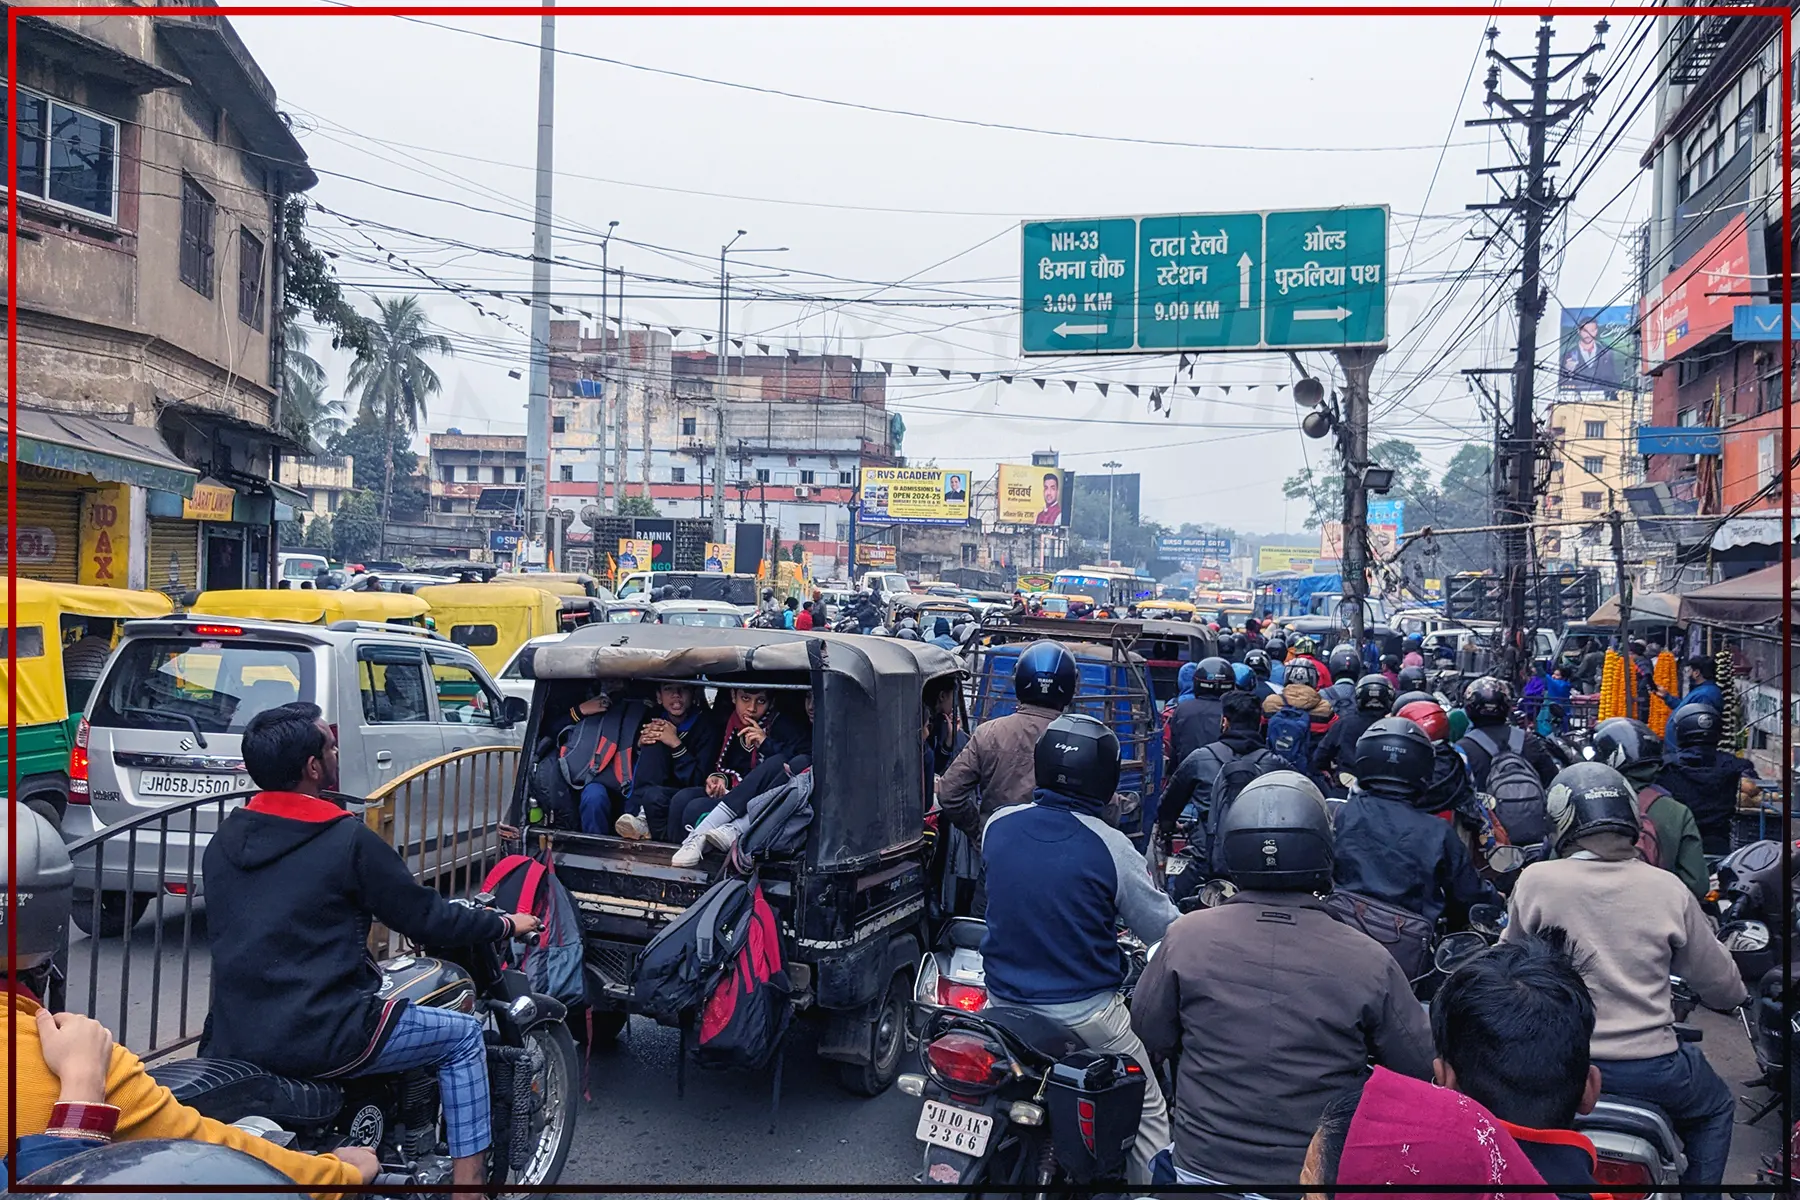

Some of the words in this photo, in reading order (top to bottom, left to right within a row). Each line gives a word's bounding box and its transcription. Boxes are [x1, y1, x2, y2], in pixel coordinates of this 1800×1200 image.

[1051, 231, 1099, 252] NH-33
[1150, 236, 1186, 259] टाटा
[1190, 229, 1229, 256] रेलवे
[1304, 225, 1347, 252] ओल्ड
[1038, 256, 1086, 281] डिमना
[1089, 254, 1126, 280] चौक
[1157, 262, 1208, 287] स्टेशन
[1274, 262, 1346, 295] पुरुलिया
[1350, 264, 1381, 285] पथ
[1043, 293, 1077, 314] 3.00
[1084, 293, 1113, 312] KM
[1154, 301, 1190, 321] 9.00
[1193, 301, 1220, 320] KM
[877, 470, 895, 480] RVS
[897, 471, 942, 480] ACADEMY
[1008, 485, 1032, 497] नववर्ष
[636, 531, 672, 541] RAMNIK
[147, 776, 230, 794] JH05BJ5500
[930, 1107, 947, 1123] JH
[949, 1112, 962, 1128] 10
[965, 1117, 983, 1134] AK
[929, 1124, 977, 1150] 2366
